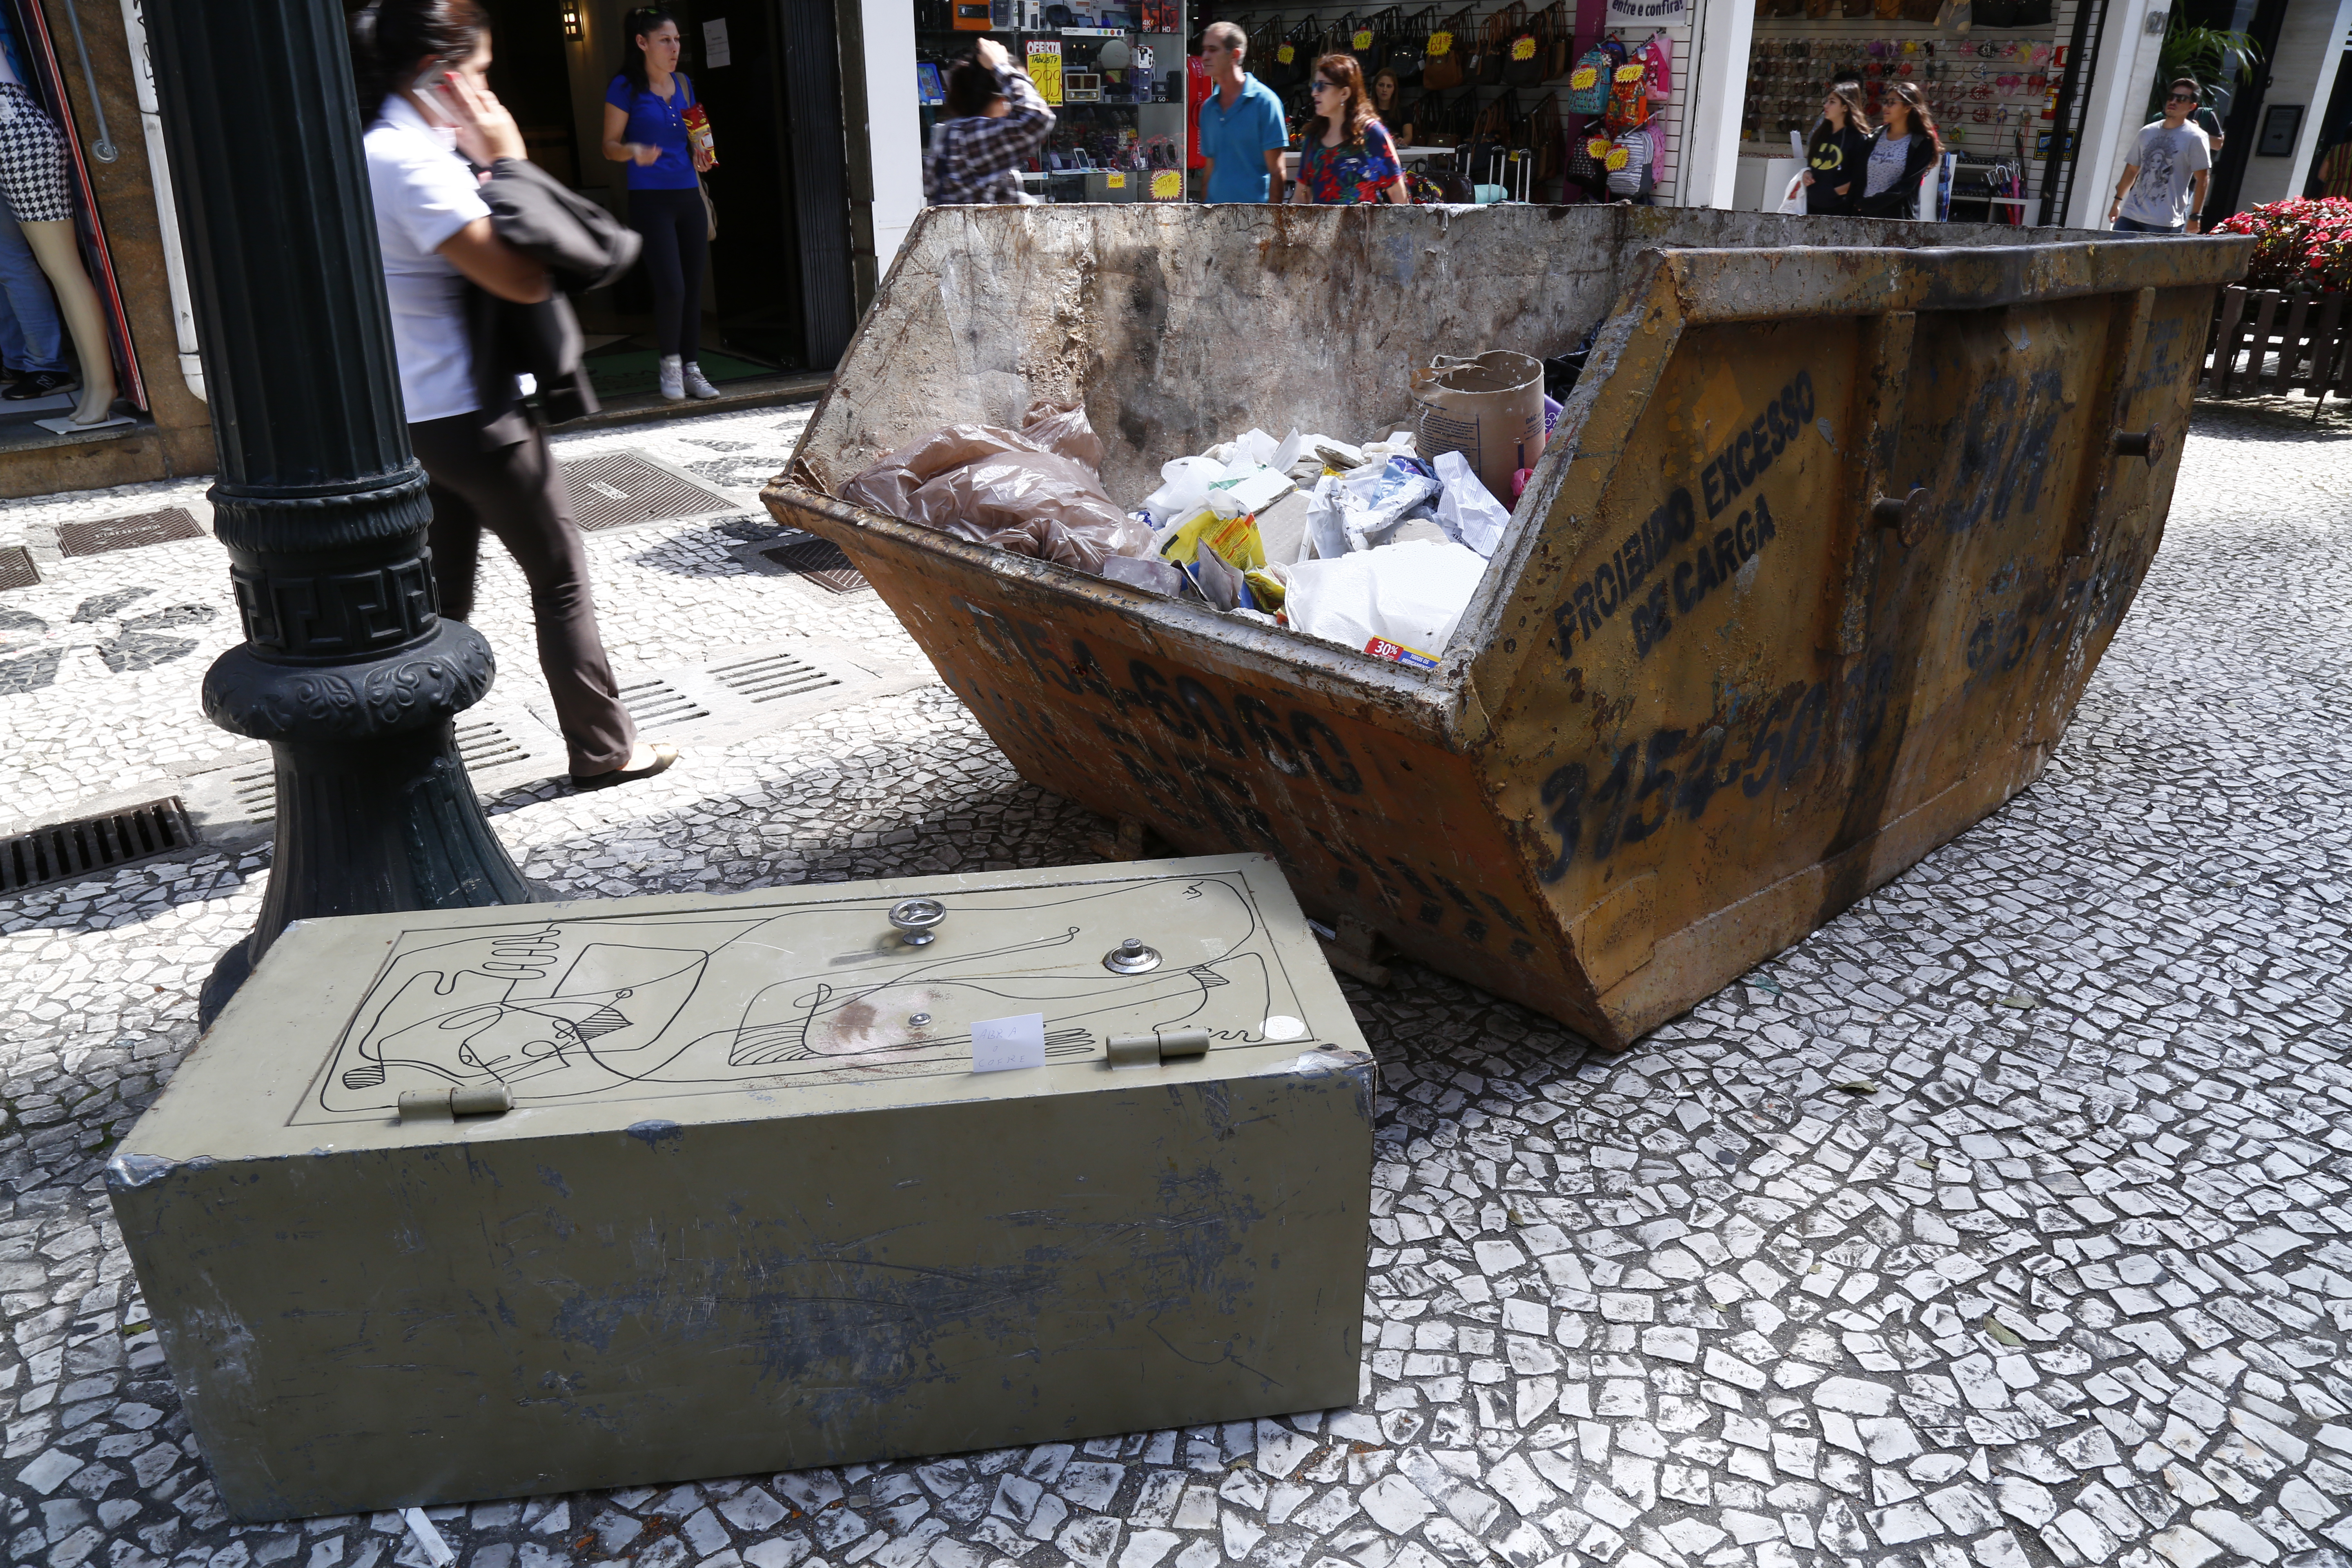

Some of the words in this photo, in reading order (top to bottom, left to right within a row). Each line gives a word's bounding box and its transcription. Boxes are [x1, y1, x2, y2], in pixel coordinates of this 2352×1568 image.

[1612, 0, 1636, 16] entre
[1638, 5, 1643, 16] e
[1646, 0, 1683, 16] confira!
[1027, 41, 1062, 55] OFERTA
[1553, 487, 1696, 661] PROIBIDO
[1701, 370, 1816, 520] EXCESSO
[1673, 493, 1776, 615] CARGA
[1374, 640, 1399, 656] 30%
[1410, 654, 1424, 662] TODOS
[978, 1055, 1025, 1067] COFRE
